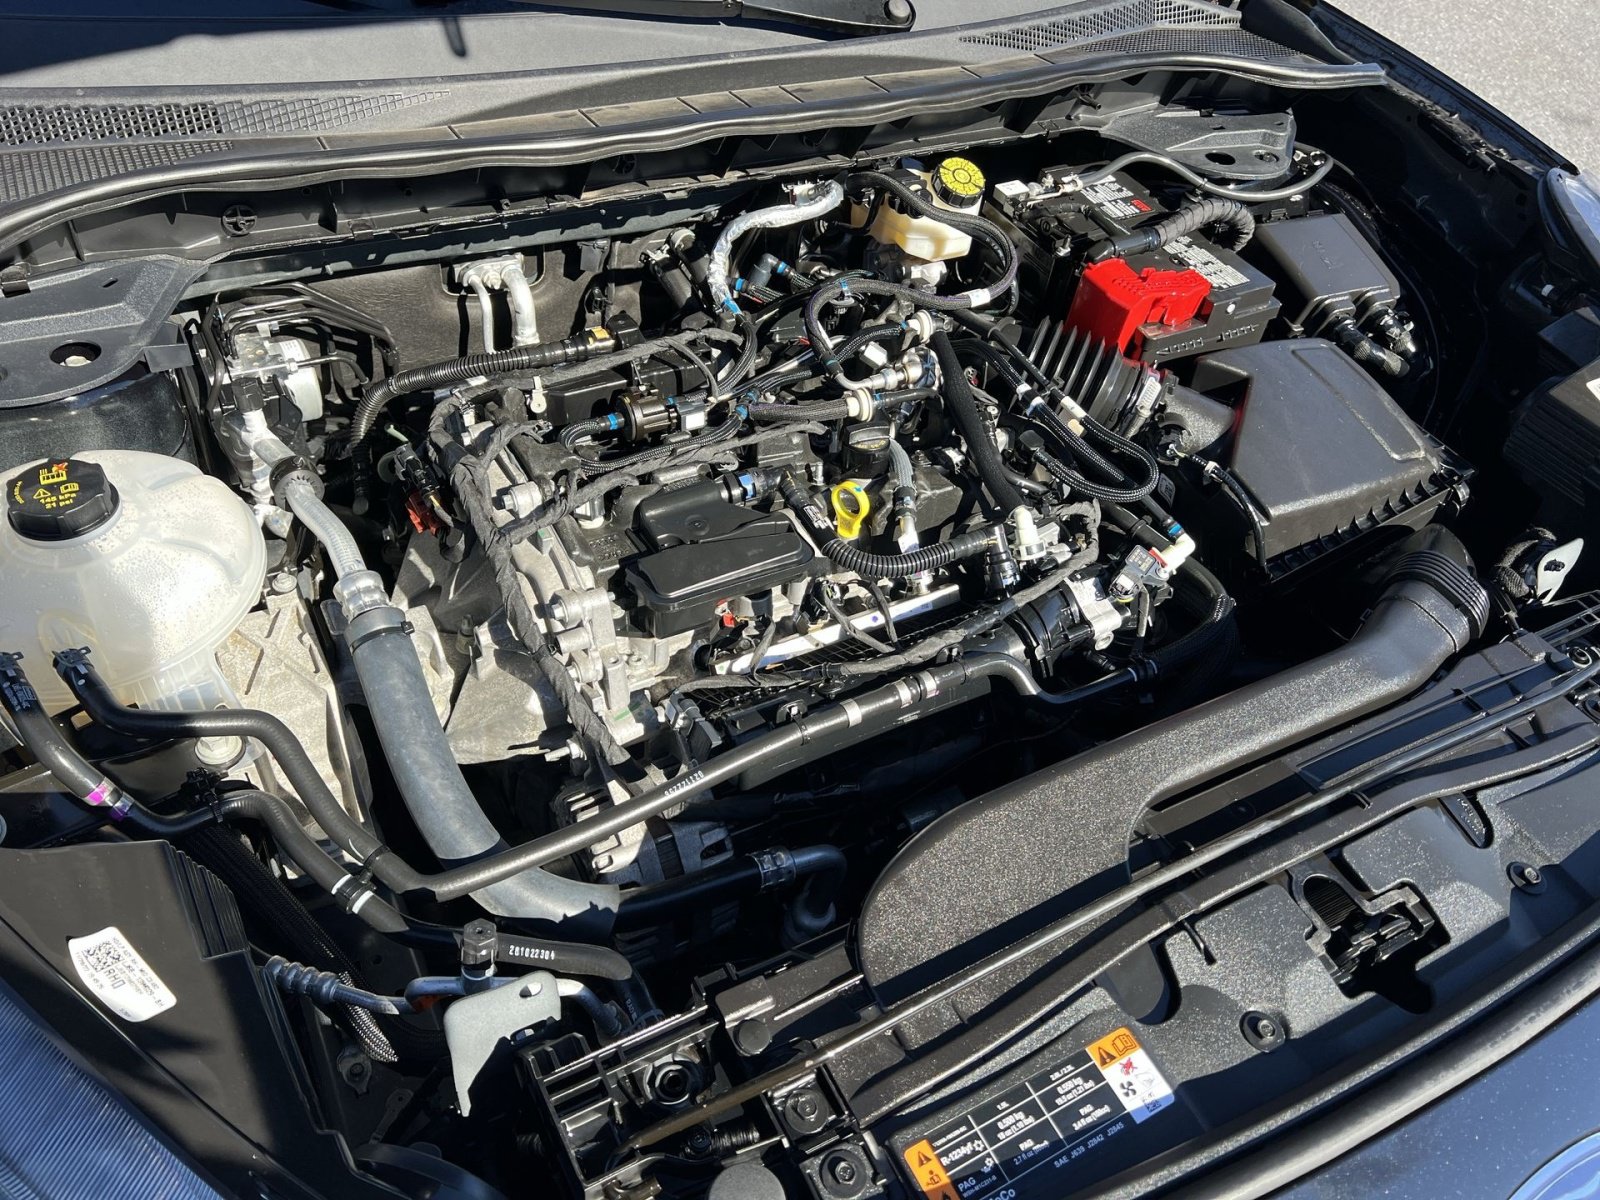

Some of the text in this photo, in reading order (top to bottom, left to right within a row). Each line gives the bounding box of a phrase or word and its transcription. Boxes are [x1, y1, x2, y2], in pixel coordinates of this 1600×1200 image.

[940, 1142, 973, 1166] R-1234yf
[1054, 1156, 1069, 1168] SAE
[1071, 1146, 1085, 1158] J639
[1087, 1134, 1104, 1148] J2842
[958, 1177, 976, 1192] PAG
